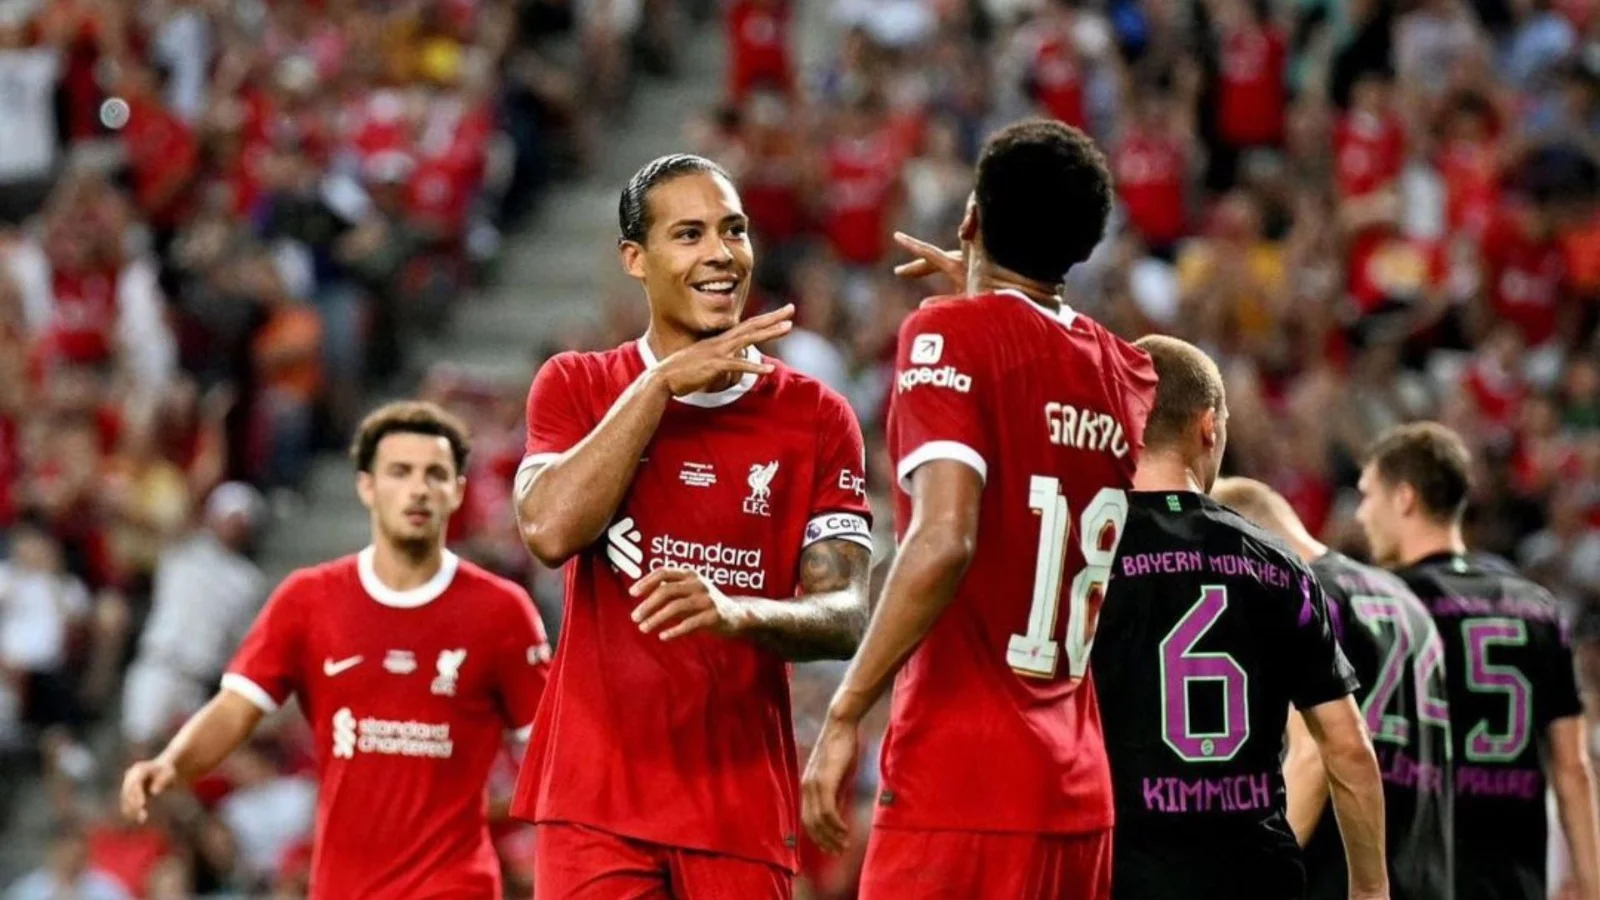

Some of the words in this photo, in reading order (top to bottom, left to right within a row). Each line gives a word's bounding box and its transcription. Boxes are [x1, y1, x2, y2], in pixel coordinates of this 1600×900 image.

[650, 534, 761, 568] standard
[1006, 474, 1128, 685] 18
[1121, 551, 1203, 577] BAYERN
[1208, 554, 1290, 589] MÜNCHEN
[1158, 584, 1249, 762] 6
[1460, 617, 1532, 763] 5
[1142, 772, 1271, 812] KIMMICH
